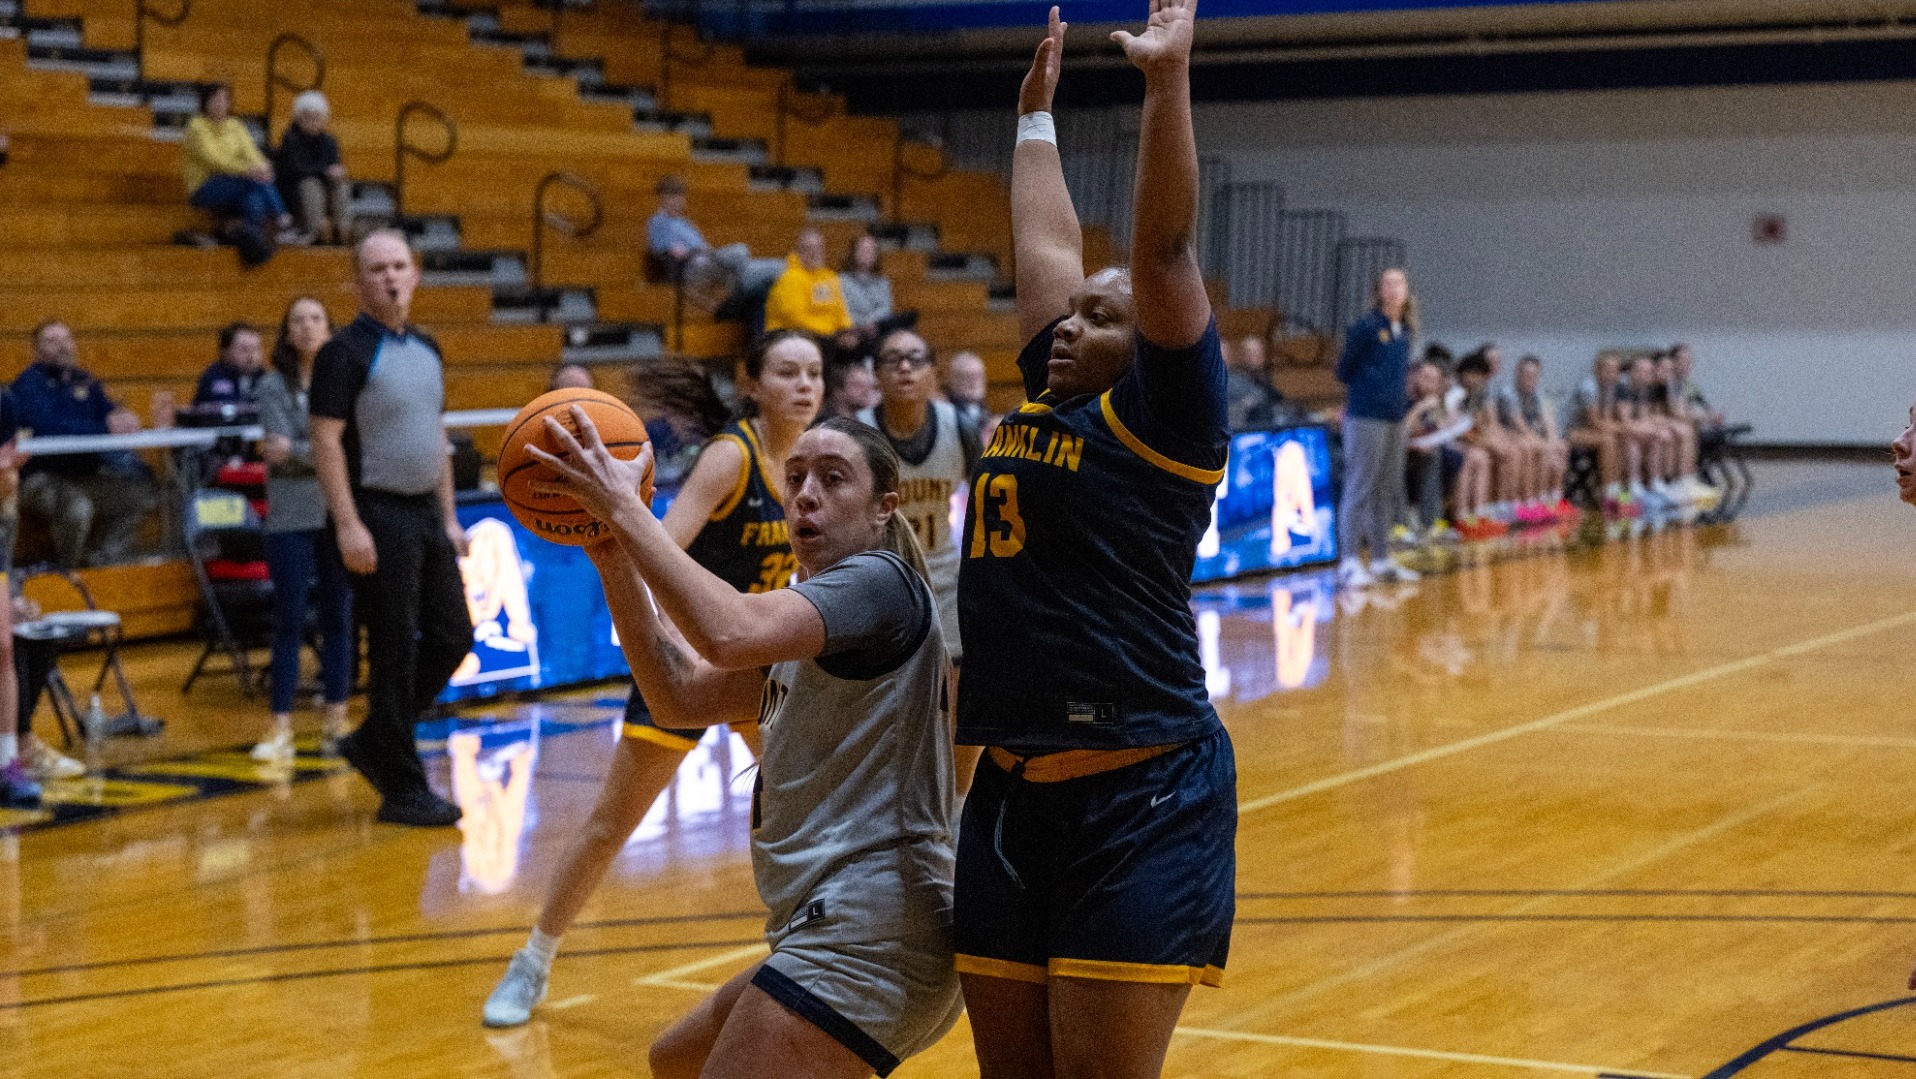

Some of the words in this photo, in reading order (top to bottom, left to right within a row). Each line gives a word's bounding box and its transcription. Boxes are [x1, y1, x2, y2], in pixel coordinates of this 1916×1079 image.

[980, 424, 1085, 473] ANKLIN
[898, 477, 952, 507] OUNT
[969, 472, 1027, 559] 13
